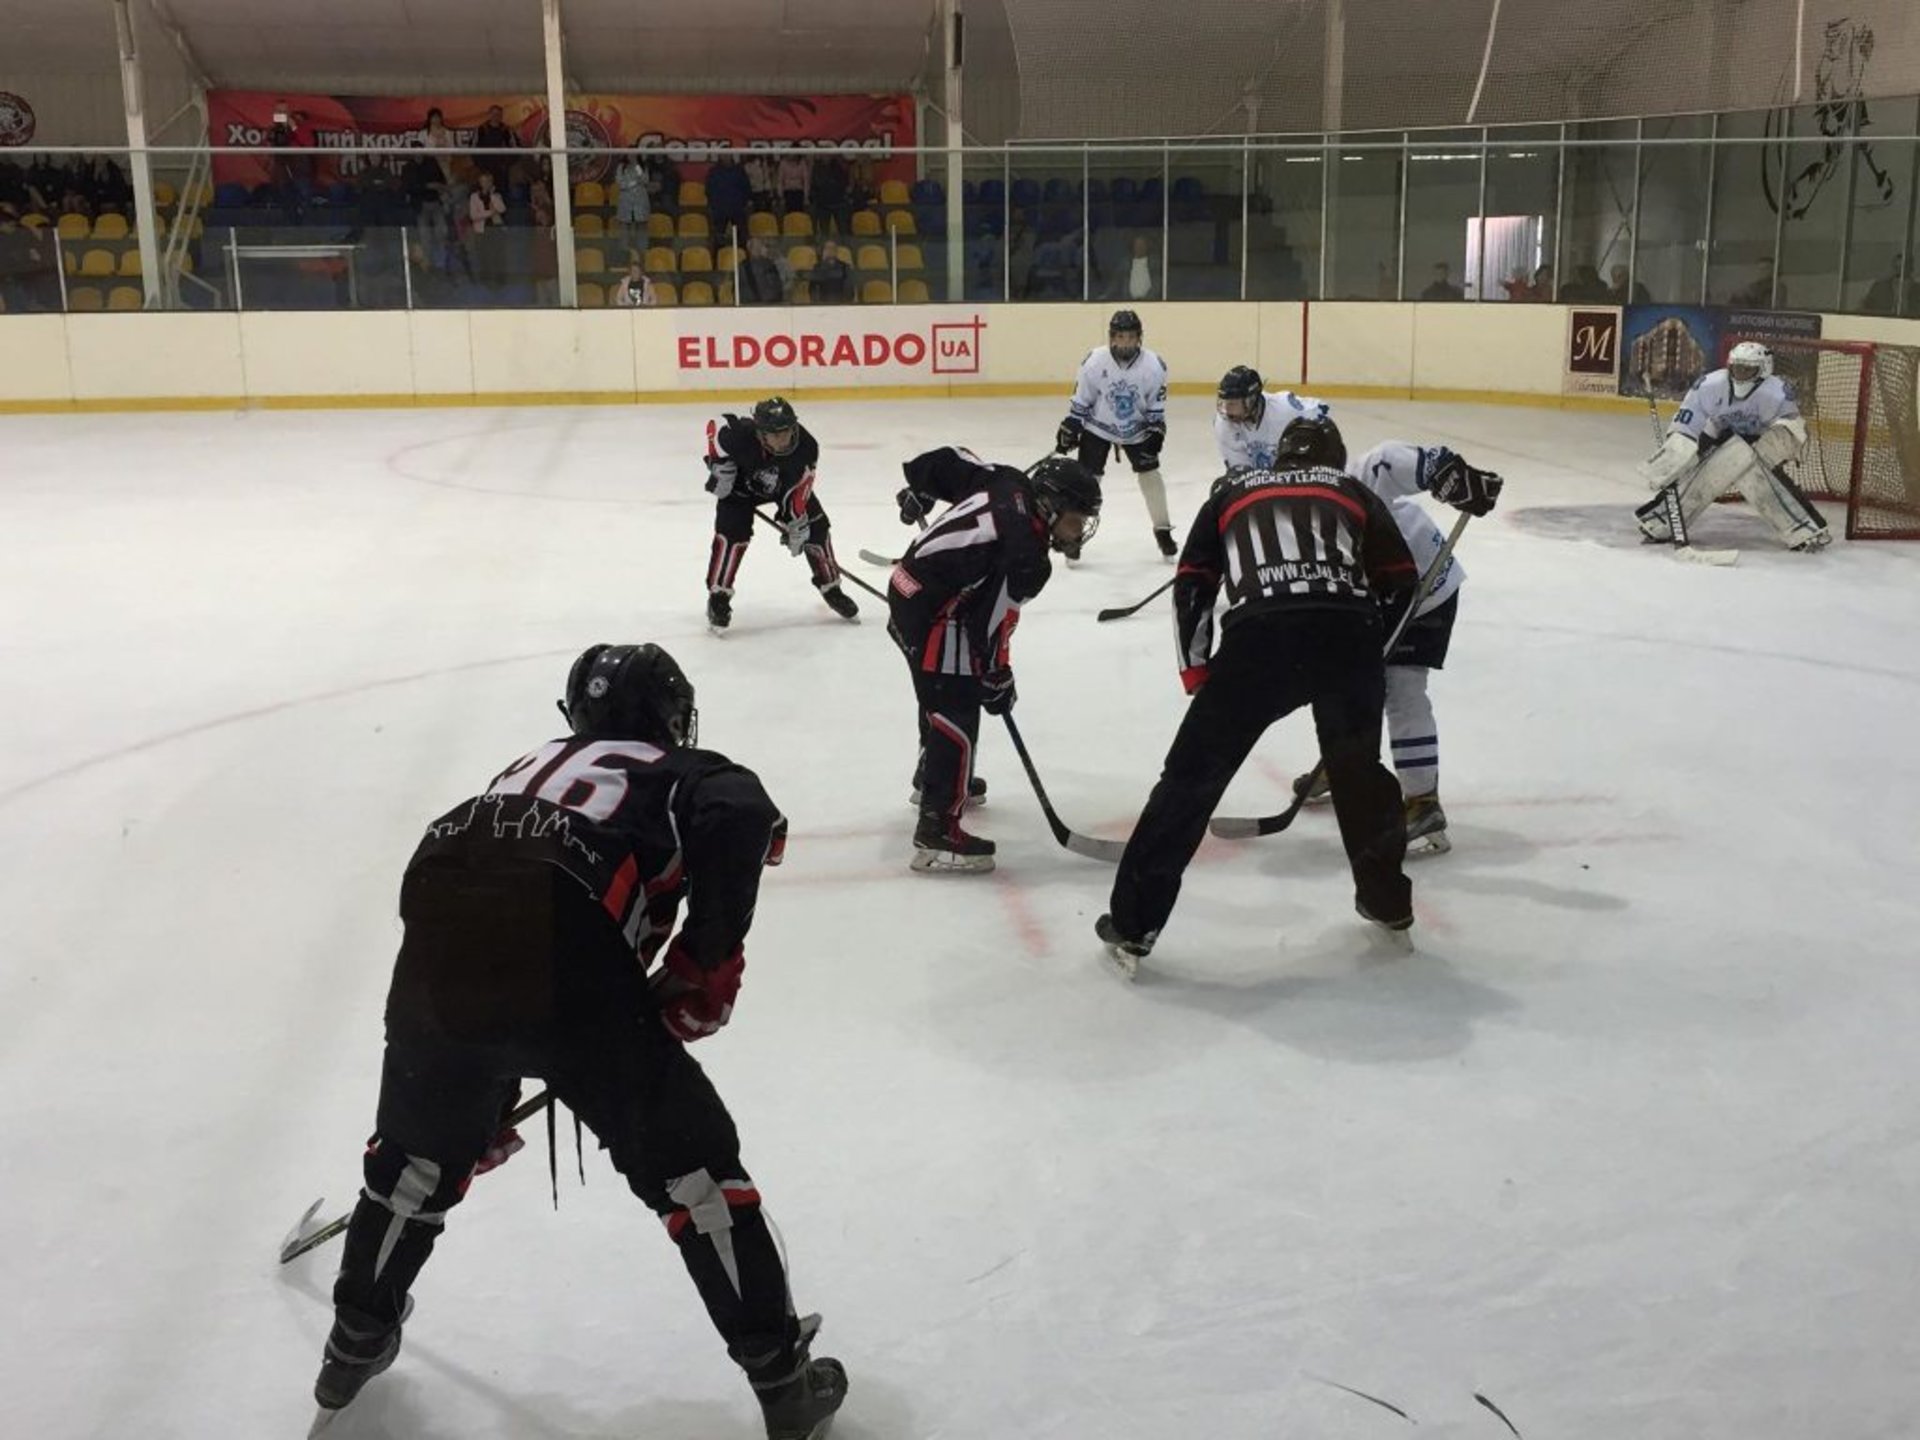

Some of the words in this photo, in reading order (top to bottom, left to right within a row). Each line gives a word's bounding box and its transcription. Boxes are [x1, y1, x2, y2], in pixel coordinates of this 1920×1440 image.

[677, 333, 926, 368] ELDORADO
[940, 340, 971, 357] UA
[1245, 473, 1292, 488] HOCKEY
[1295, 473, 1341, 487] LEAGUE
